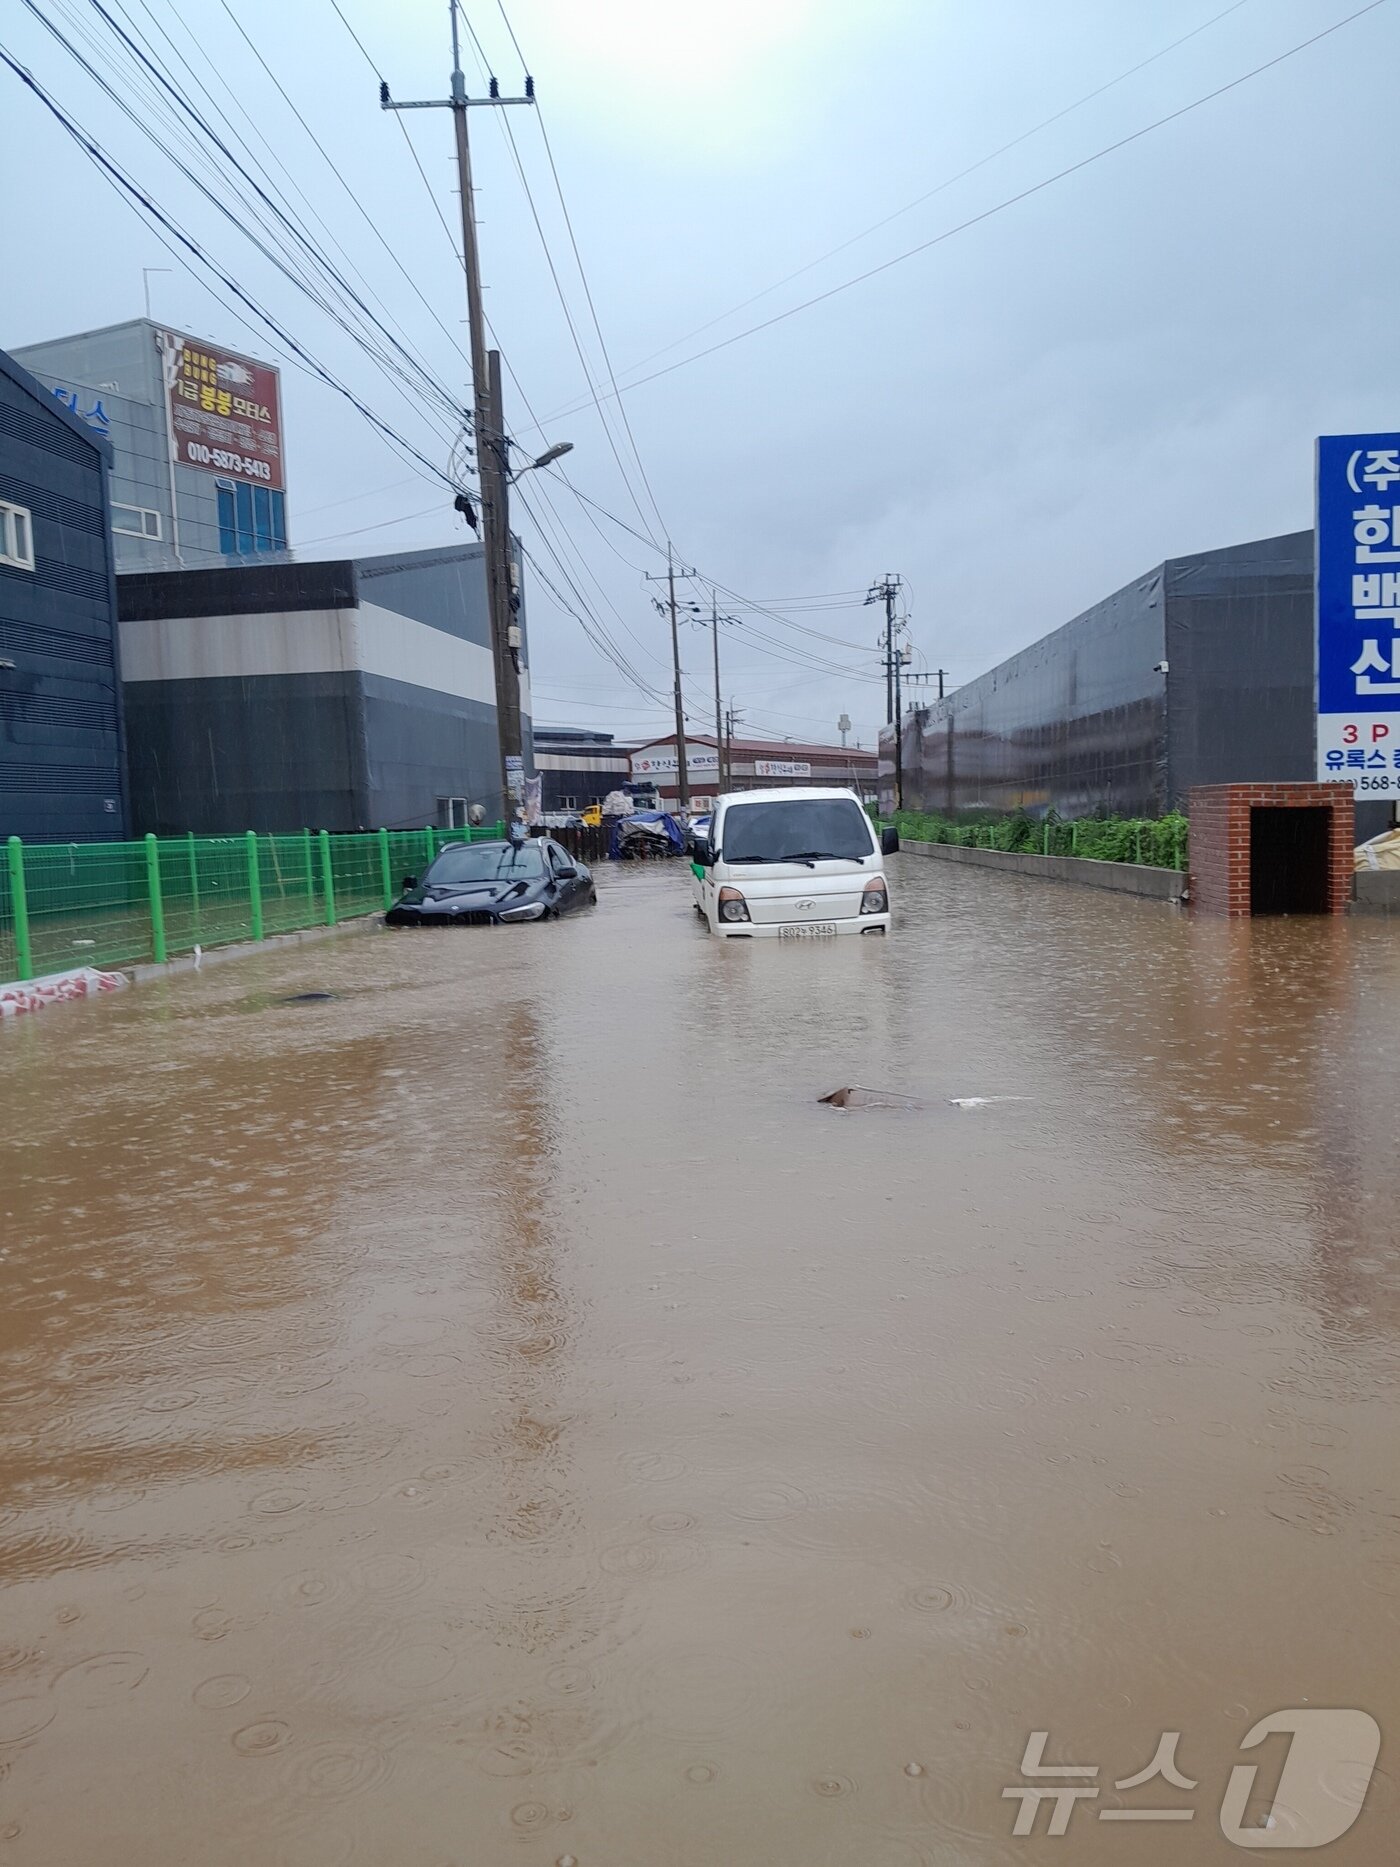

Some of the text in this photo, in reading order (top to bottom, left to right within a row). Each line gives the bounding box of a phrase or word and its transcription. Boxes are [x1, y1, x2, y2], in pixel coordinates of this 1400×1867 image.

[200, 383, 232, 417] 봉봉
[233, 396, 272, 424] 모터스
[1343, 724, 1389, 743] 3 P
[1325, 749, 1387, 771] 유록스
